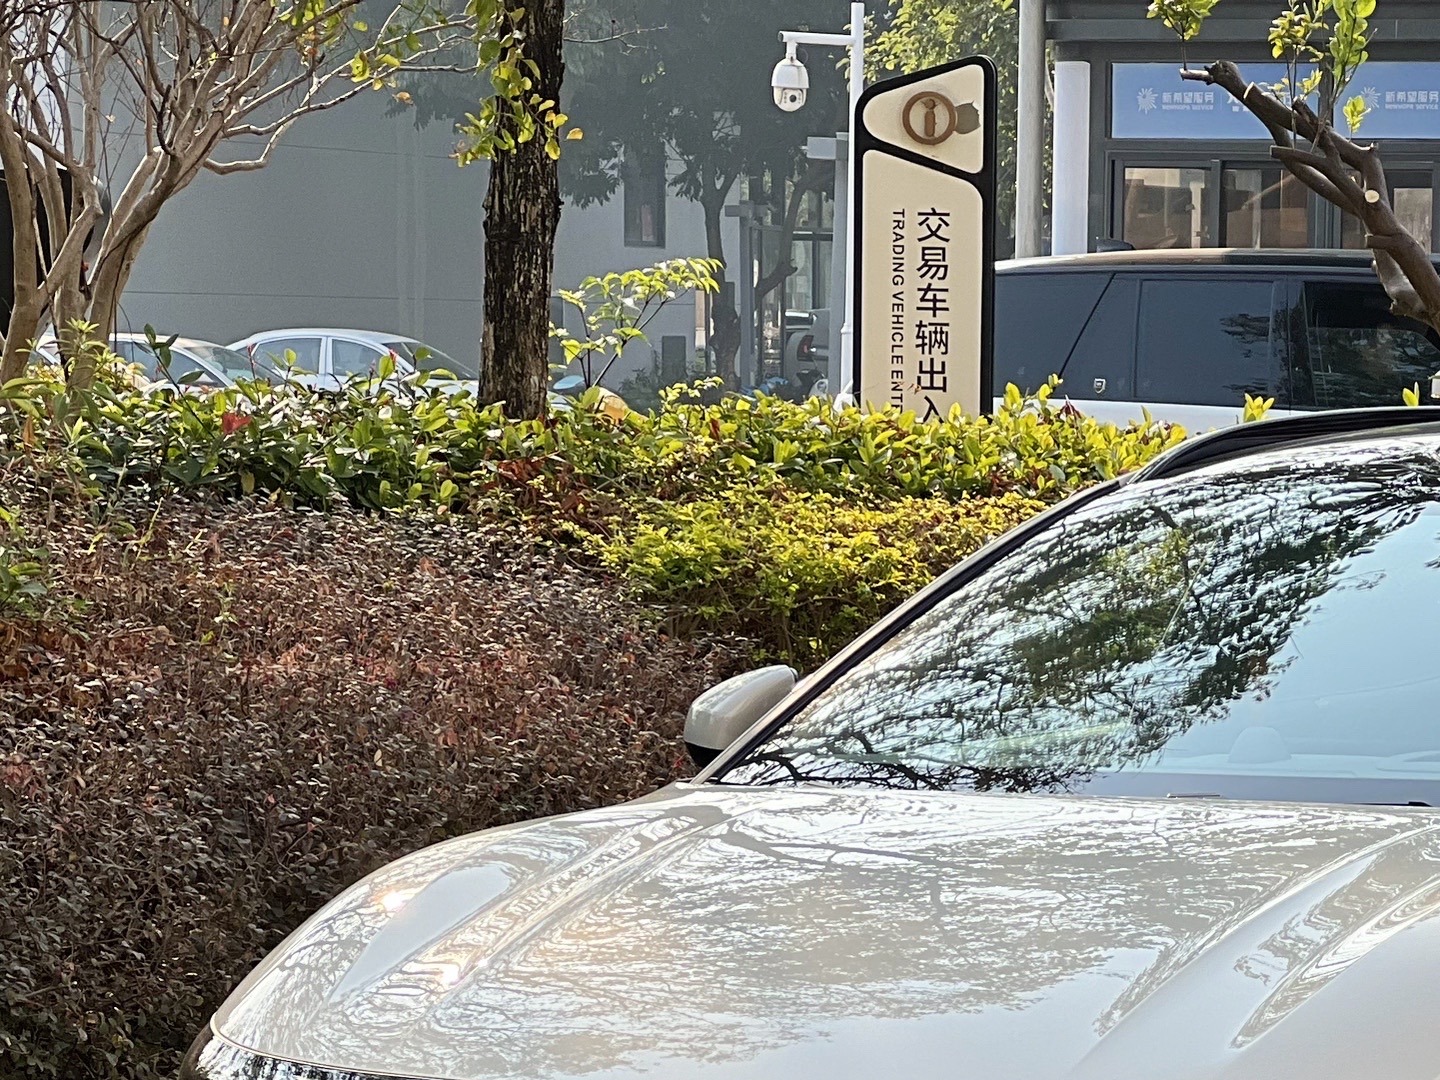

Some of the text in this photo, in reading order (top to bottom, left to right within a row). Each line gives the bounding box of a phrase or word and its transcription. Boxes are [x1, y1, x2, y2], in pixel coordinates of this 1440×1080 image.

[891, 208, 905, 287] TRADING
[890, 291, 905, 365] VEHICLE
[915, 207, 951, 424] 交易车辆出入
